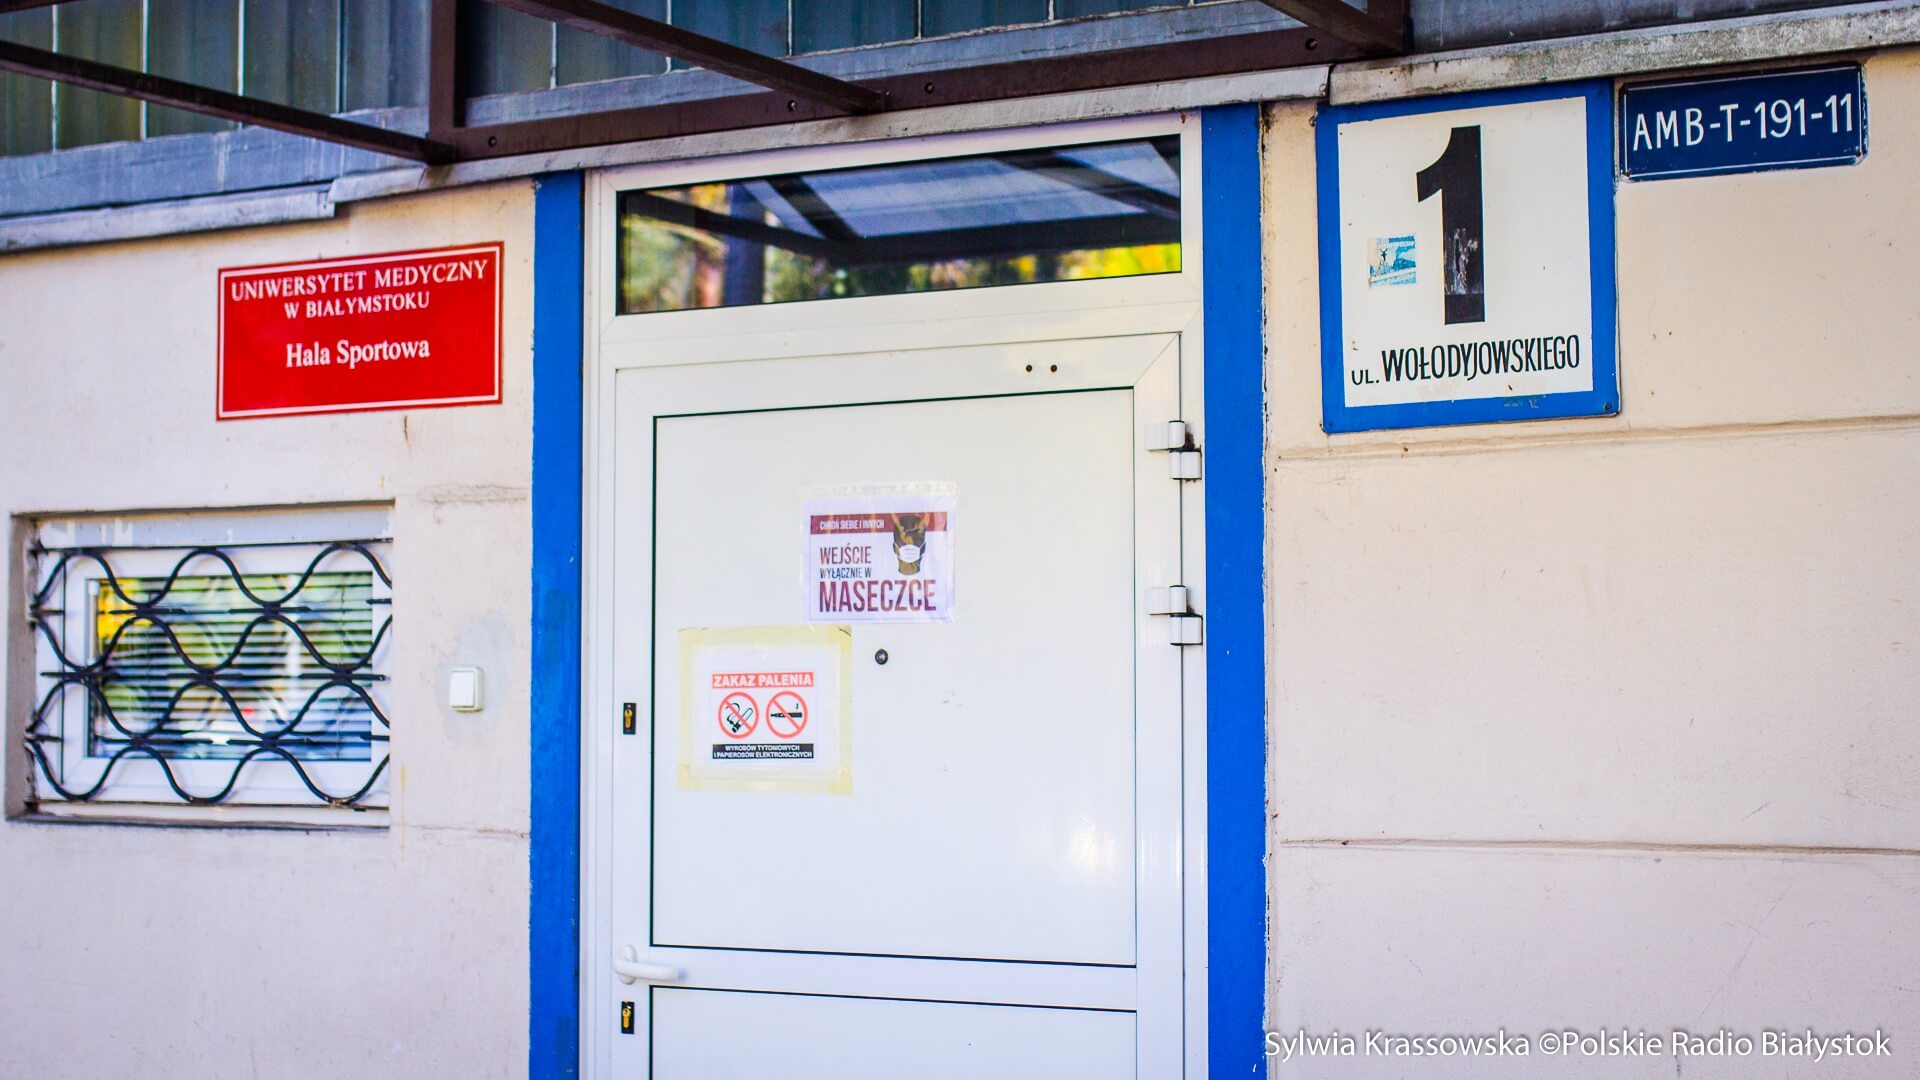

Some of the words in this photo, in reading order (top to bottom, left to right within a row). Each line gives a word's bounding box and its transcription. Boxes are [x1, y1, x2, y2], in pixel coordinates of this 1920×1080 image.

[1633, 93, 1853, 151] AMB-T-191-11
[1416, 124, 1485, 325] 1
[231, 270, 367, 302] UNIWERSYTET
[374, 259, 488, 288] MEDYCZNY
[284, 302, 300, 319] W
[306, 291, 430, 318] BIAŁYMSTOKU
[286, 341, 331, 368] Hala
[337, 339, 430, 369] Sportowa
[1381, 334, 1580, 382] WOŁODYJOWSKIEGO
[820, 542, 872, 565] WEJŚCIE
[820, 567, 863, 580] WYŁĄCZNIE
[864, 567, 872, 578] W
[819, 579, 937, 613] MASECZCE
[714, 675, 756, 687] ZAKAZ
[759, 674, 811, 686] PALENIA
